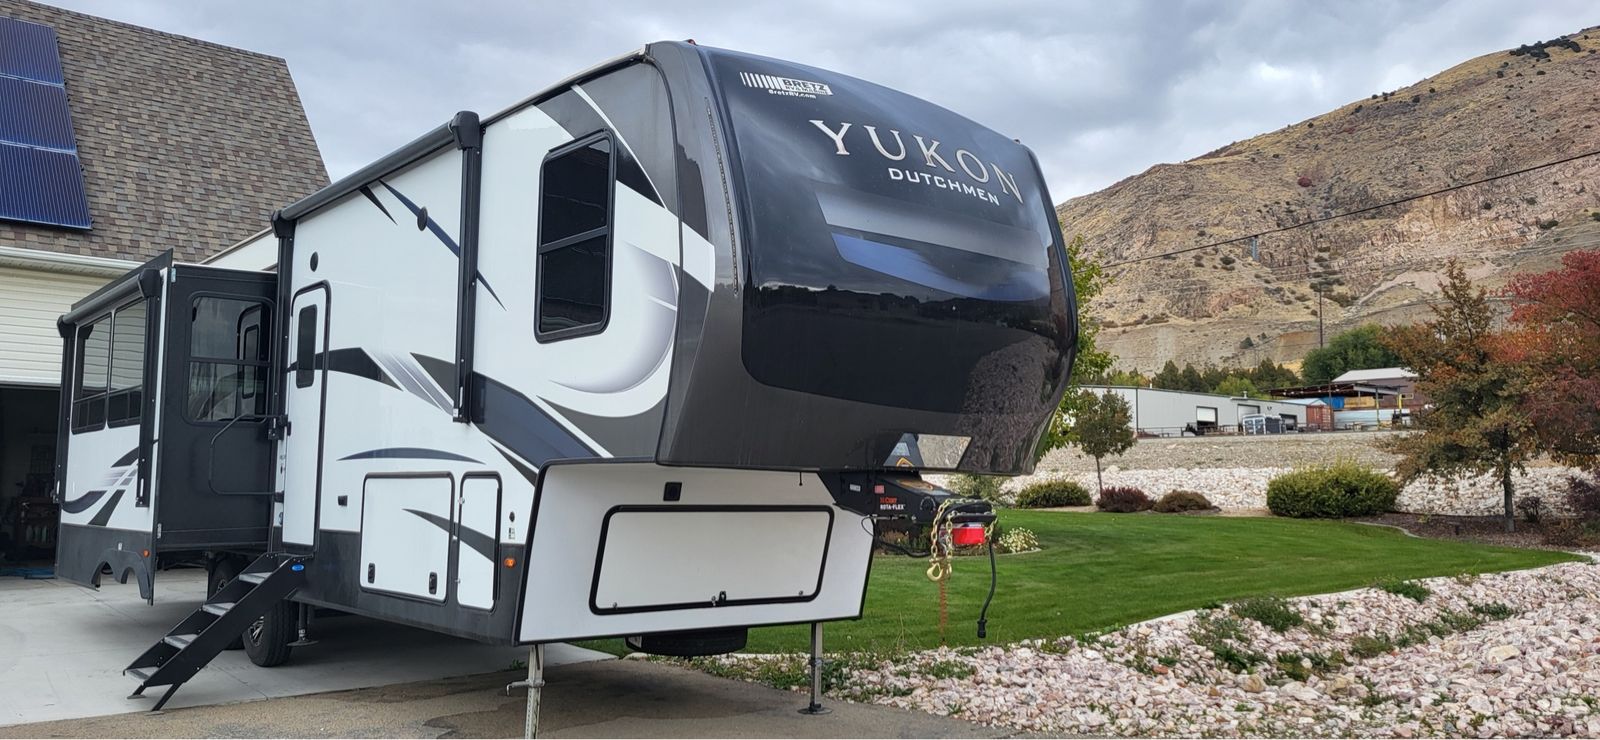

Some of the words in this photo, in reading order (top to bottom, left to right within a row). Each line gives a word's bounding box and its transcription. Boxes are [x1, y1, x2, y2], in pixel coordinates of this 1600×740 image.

[768, 89, 817, 99] BretzRV.com
[781, 79, 826, 91] BRETZ
[809, 120, 1023, 204] YUKON
[888, 168, 1000, 206] DUTCHMEN
